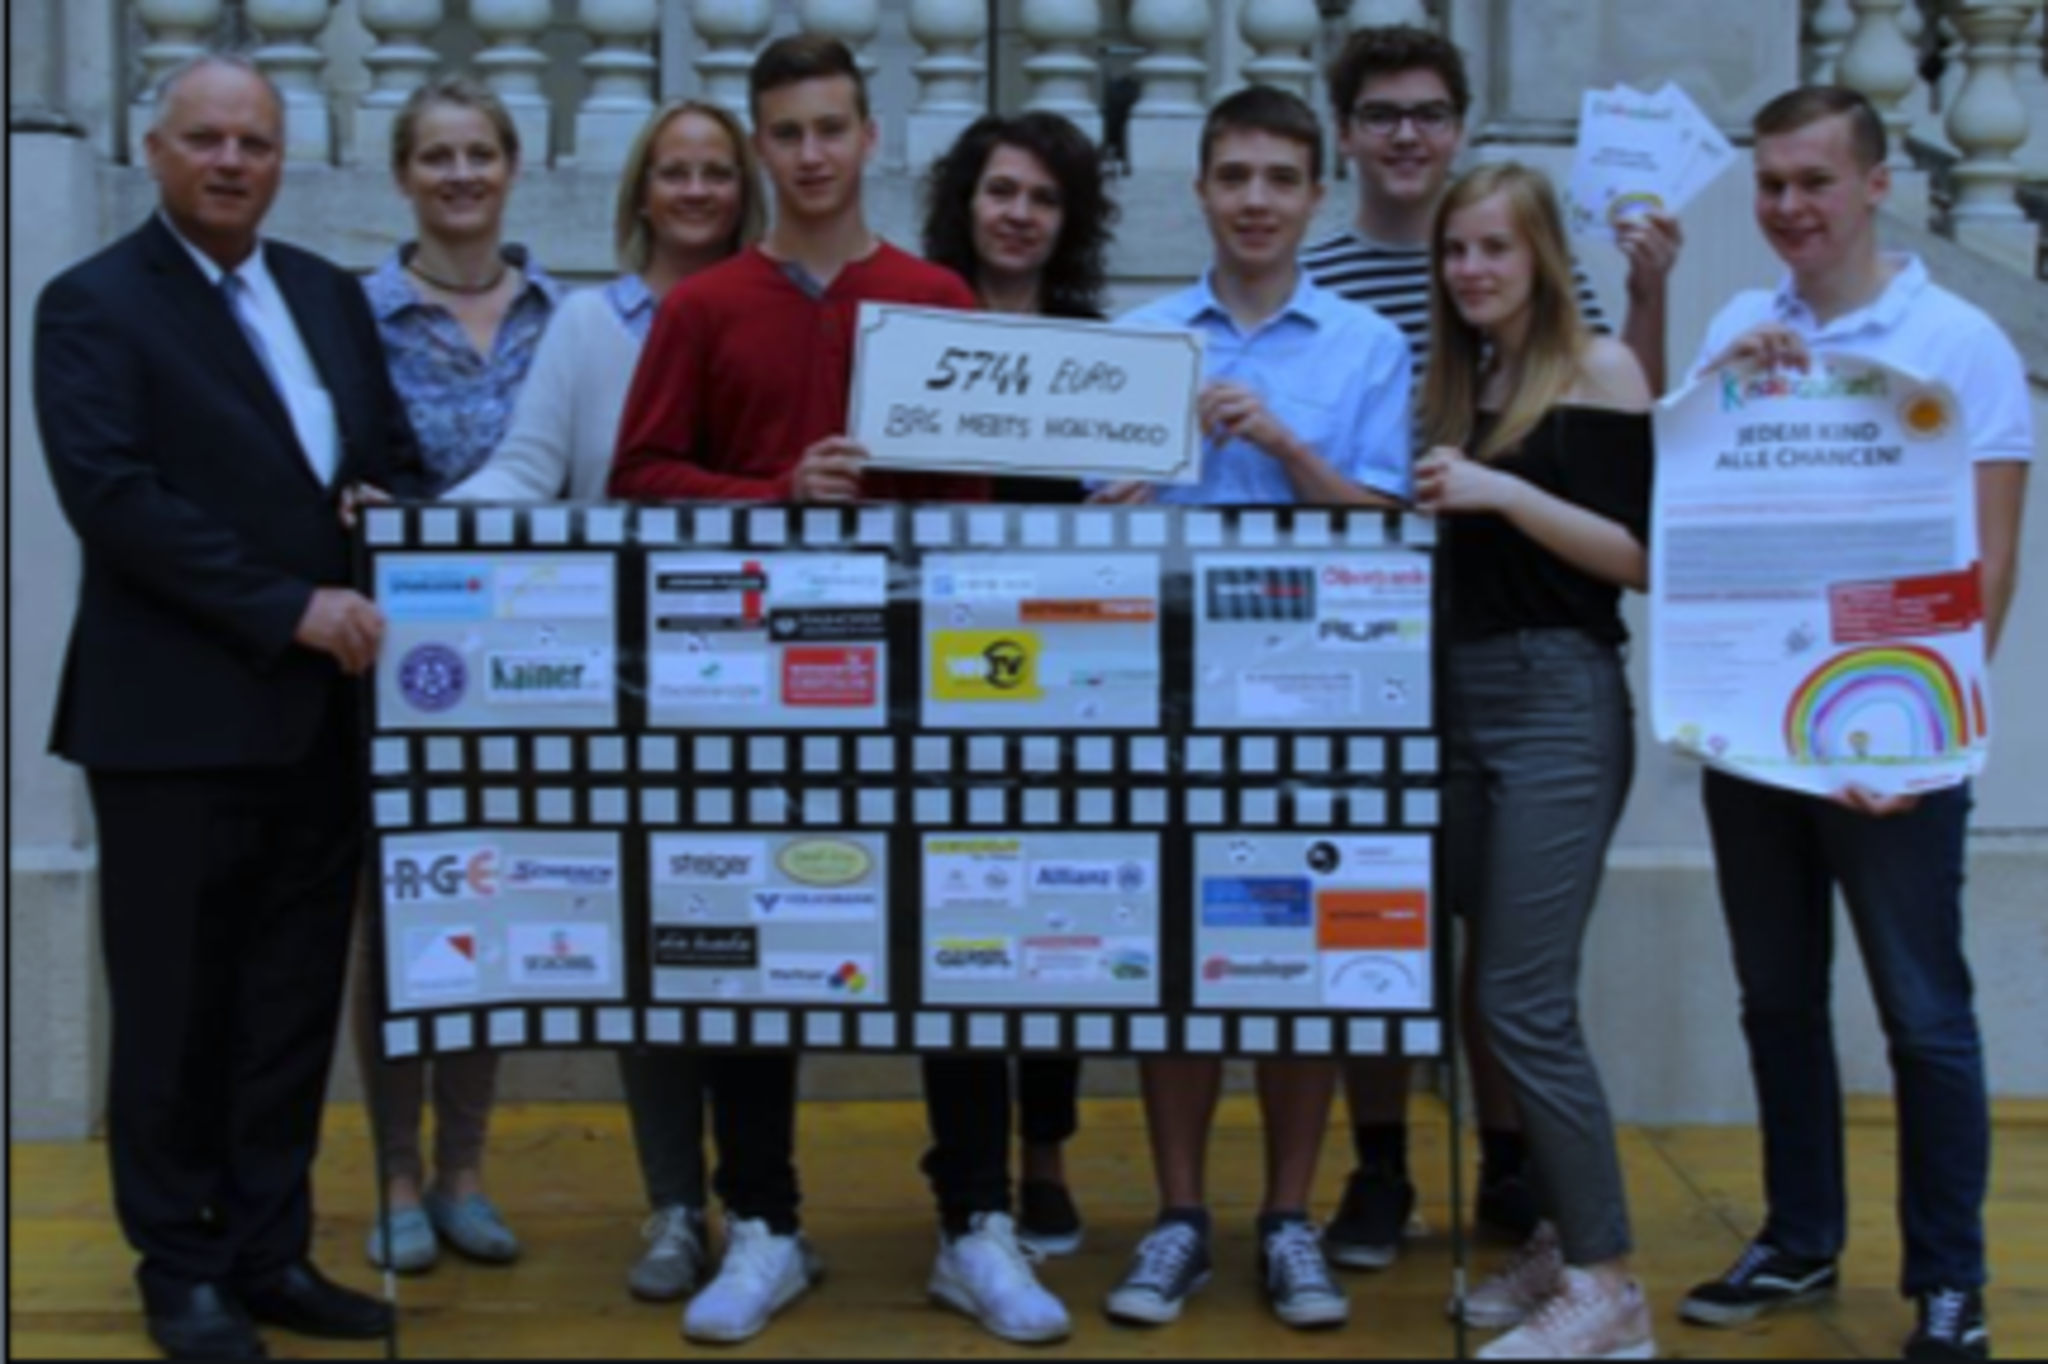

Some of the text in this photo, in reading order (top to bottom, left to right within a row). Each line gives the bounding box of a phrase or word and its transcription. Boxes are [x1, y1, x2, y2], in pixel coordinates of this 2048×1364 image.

[926, 347, 1128, 395] 5744 EURO
[957, 412, 1031, 440] MEETS
[1045, 417, 1170, 447] HOLLYWOOD
[1737, 421, 1881, 447] JEDEM KIND
[1715, 449, 1769, 470] ALLE
[1035, 867, 1112, 885] Allianz
